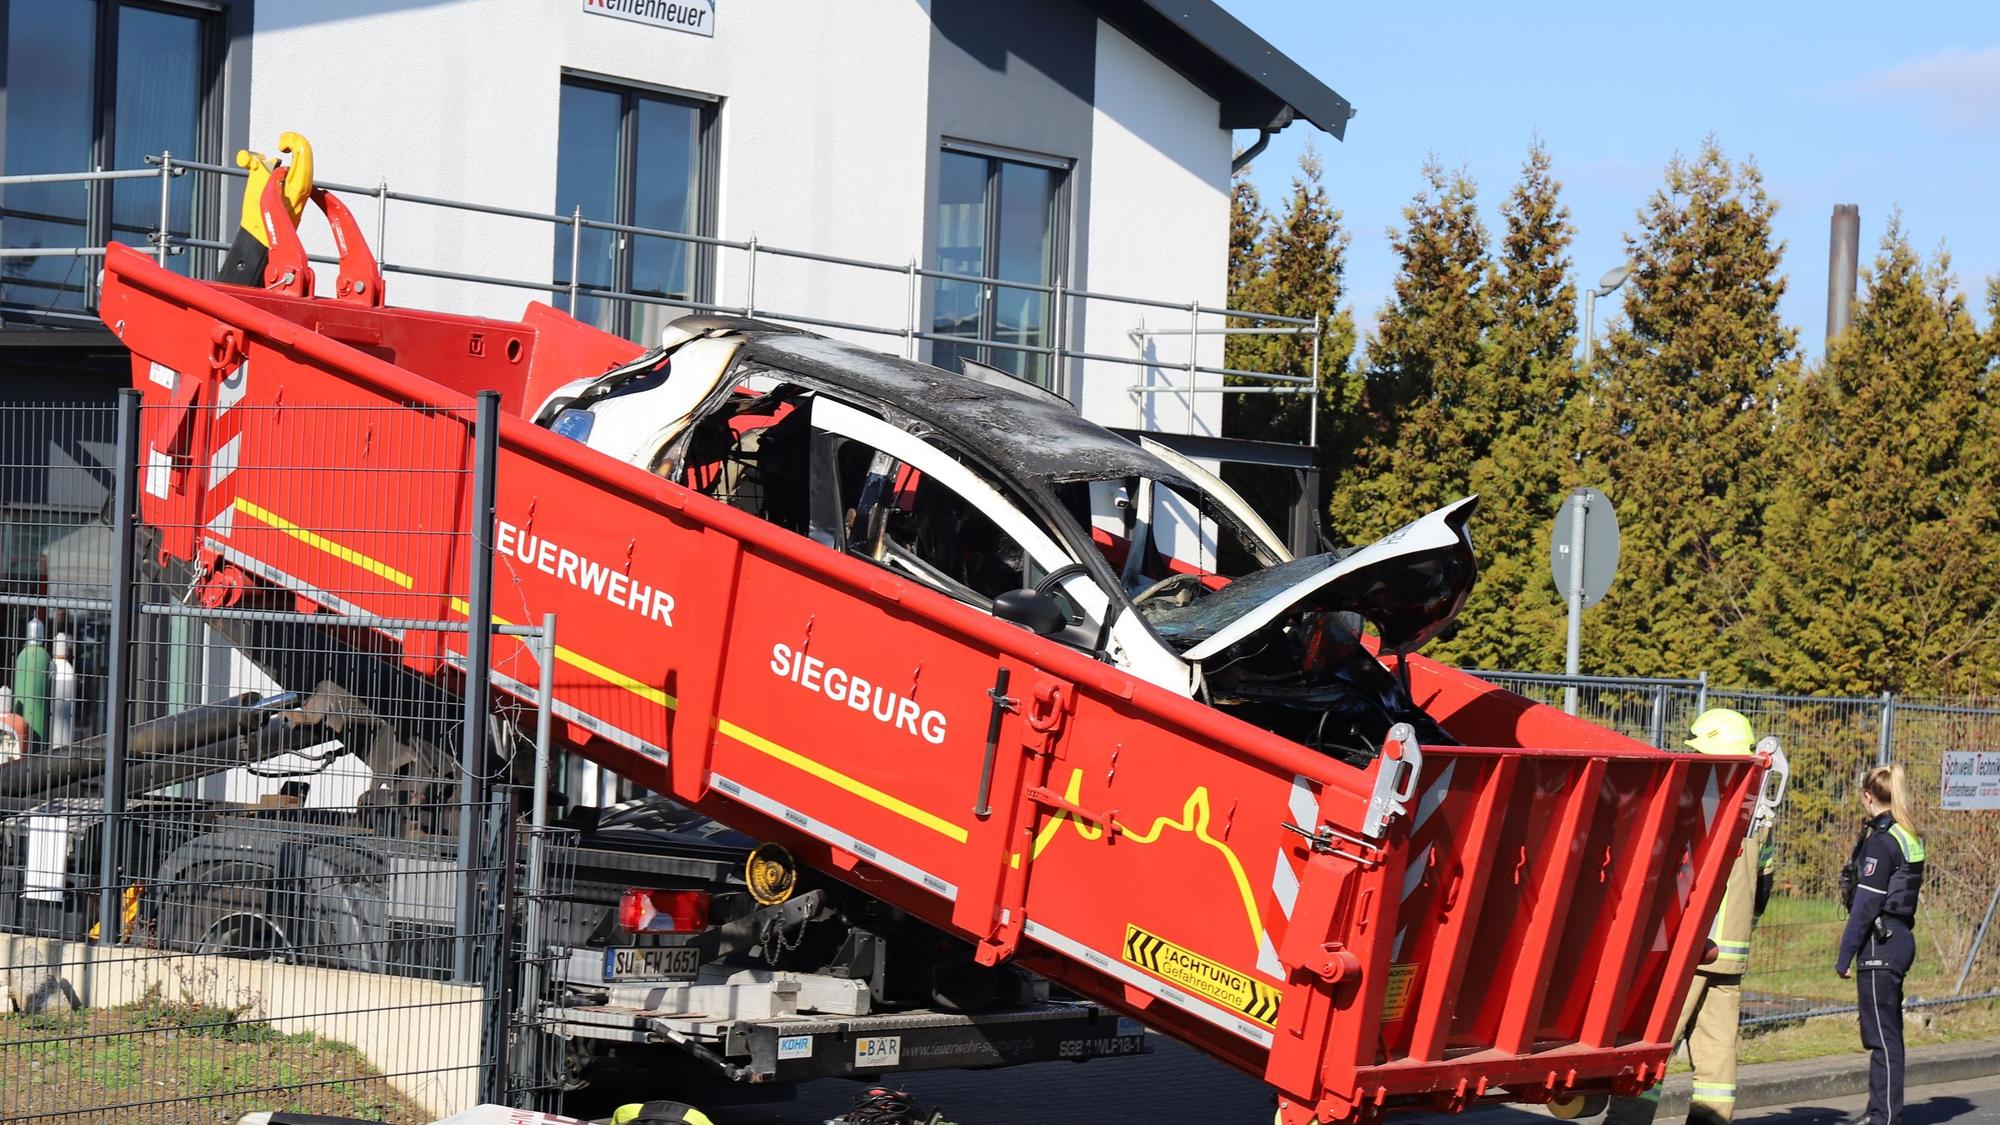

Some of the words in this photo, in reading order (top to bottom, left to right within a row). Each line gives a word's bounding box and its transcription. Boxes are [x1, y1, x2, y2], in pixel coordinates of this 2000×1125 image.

[496, 520, 675, 628] EUERWEHR
[770, 643, 947, 744] SIEGBURG
[615, 952, 634, 974] SU
[644, 951, 662, 974] FW
[664, 951, 698, 973] 1651
[1162, 961, 1243, 1006] Gefahrenzone
[1164, 947, 1247, 993] !ACHTUNG!
[868, 1038, 897, 1056] BÄR
